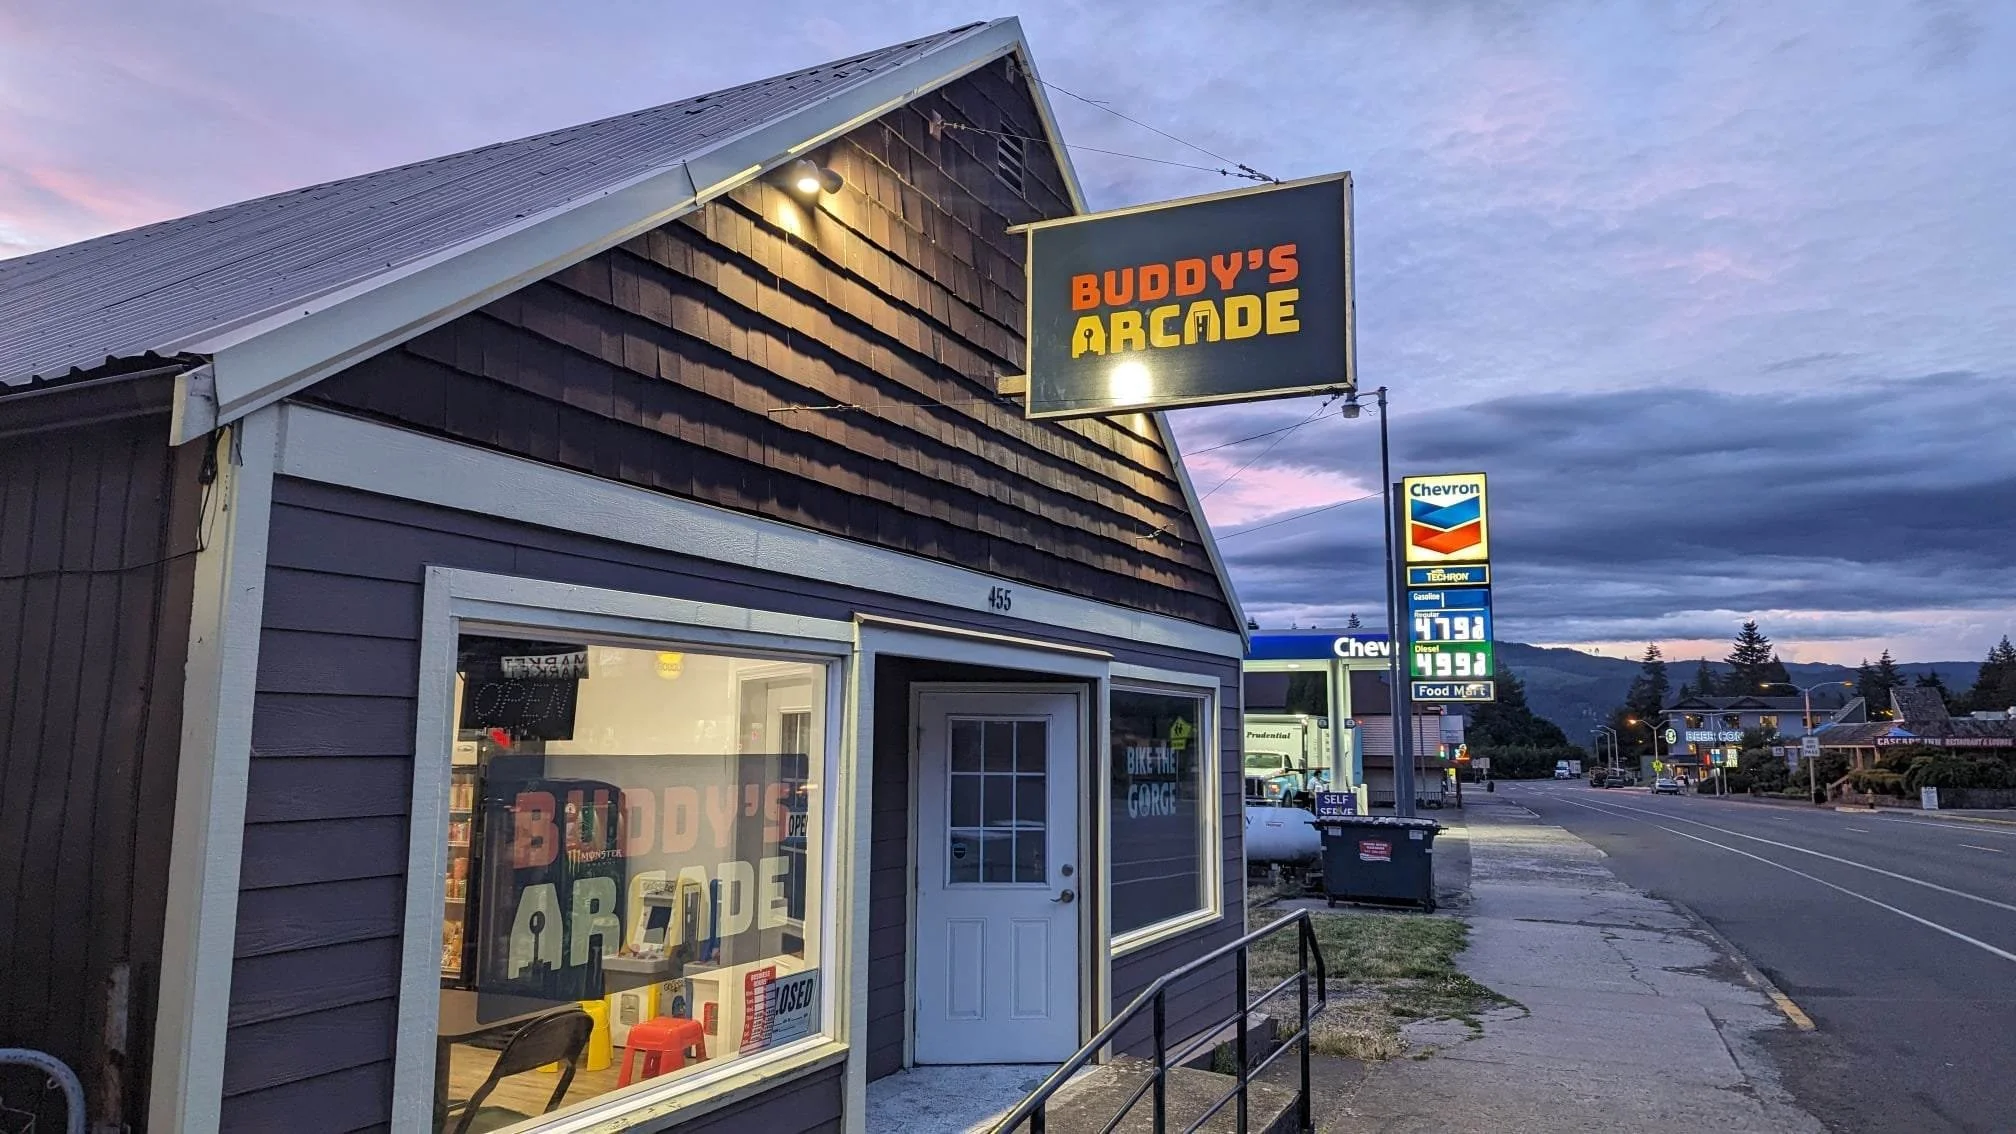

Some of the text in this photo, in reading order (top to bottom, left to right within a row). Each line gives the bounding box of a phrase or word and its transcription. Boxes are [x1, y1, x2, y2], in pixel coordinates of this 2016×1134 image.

[1072, 244, 1298, 310] BUDDY'S
[1072, 288, 1300, 358] ARCADE
[1410, 483, 1480, 497] Chevron
[1426, 573, 1469, 581] TECHRON
[988, 585, 1011, 610] 455
[1413, 593, 1440, 601] Gasoline
[1414, 645, 1440, 653] Diesel
[475, 680, 573, 717] OPEN
[1419, 685, 1450, 696] Food
[1247, 731, 1291, 739] Prudential
[1127, 746, 1176, 774] BIKE THE
[1128, 782, 1176, 818] GORGE
[1324, 795, 1349, 804] SELF
[513, 783, 791, 868] BUDDY'S
[581, 849, 622, 860] MONSTER
[508, 856, 789, 980] ARCADE
